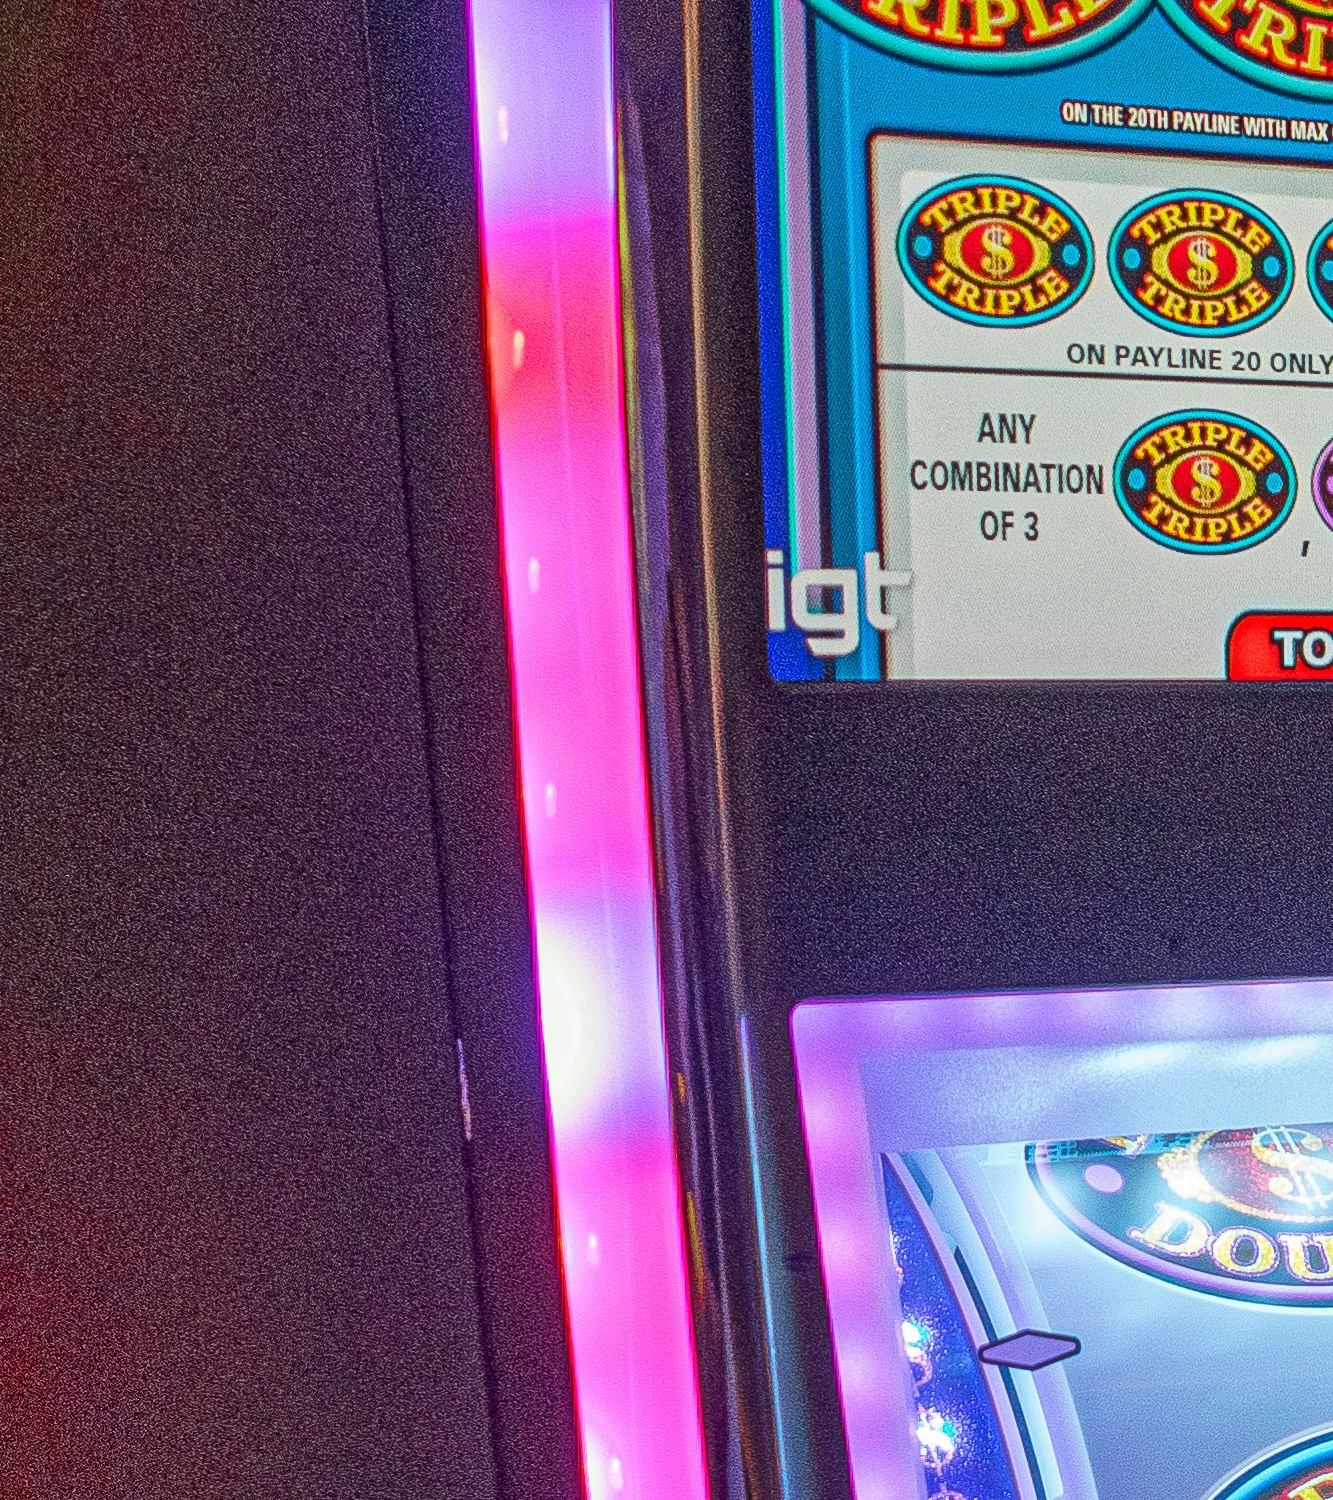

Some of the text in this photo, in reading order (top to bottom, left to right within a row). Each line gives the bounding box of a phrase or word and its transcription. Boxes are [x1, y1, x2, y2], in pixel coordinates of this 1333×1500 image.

[1062, 102, 1088, 124] ON
[1091, 104, 1124, 127] THE
[1128, 107, 1169, 131] 20TH
[1173, 111, 1240, 135] PAYLINE
[1243, 117, 1287, 139] WITH
[1291, 121, 1328, 142] MAX
[923, 188, 1071, 242] TRIPLE
[1131, 202, 1271, 253] TRIPLE
[928, 262, 1069, 316] TRIPLE
[1139, 275, 1271, 326] TRIPLE
[1067, 343, 1105, 365] ON
[1114, 345, 1221, 370] PAYLINE
[1231, 351, 1260, 373] 20
[977, 414, 1036, 444] ANY
[1135, 421, 1276, 469] TRIPLE
[910, 460, 1104, 495] COMBINATION
[980, 512, 1039, 541] OF 3
[1142, 493, 1274, 542] TRIPLE
[766, 549, 914, 657] igt
